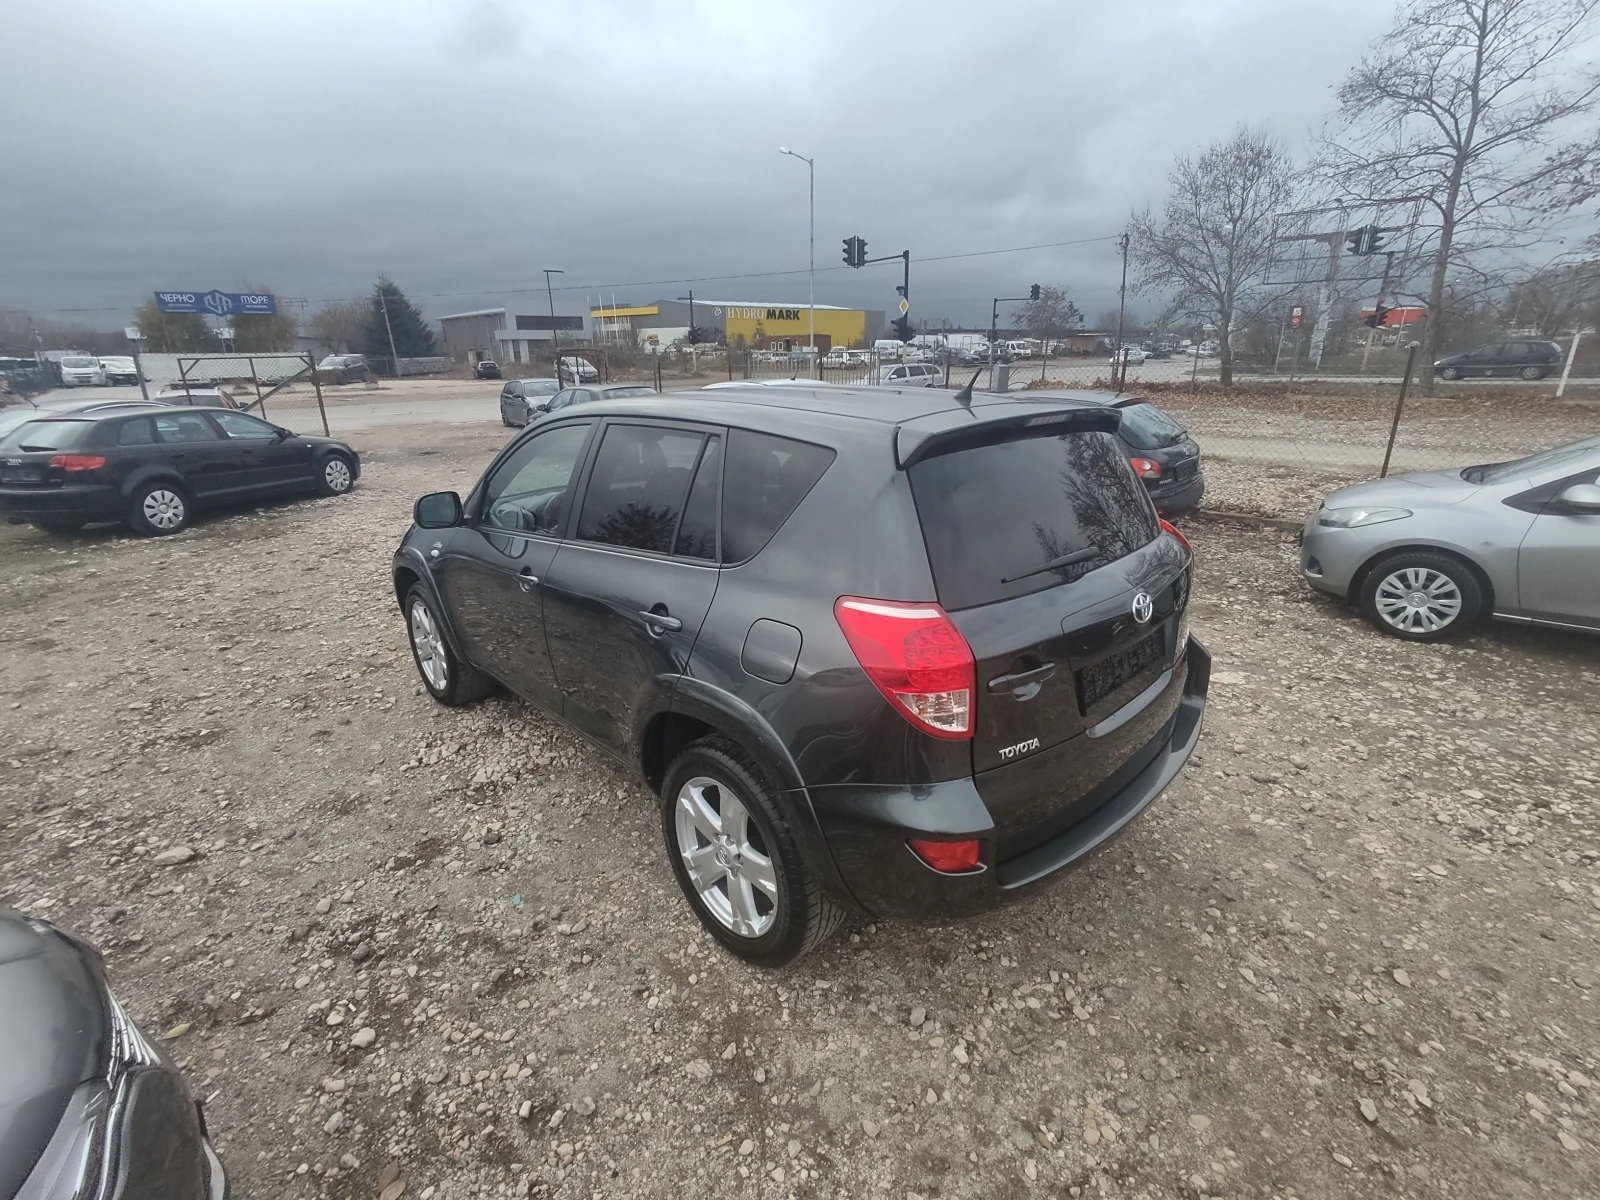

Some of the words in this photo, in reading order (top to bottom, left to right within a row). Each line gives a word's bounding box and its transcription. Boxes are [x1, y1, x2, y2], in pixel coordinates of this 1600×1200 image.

[160, 293, 195, 303] ЧЕРНО
[727, 307, 764, 320] HYDRO
[766, 309, 801, 320] MARK
[998, 737, 1040, 760] TOYOTA
